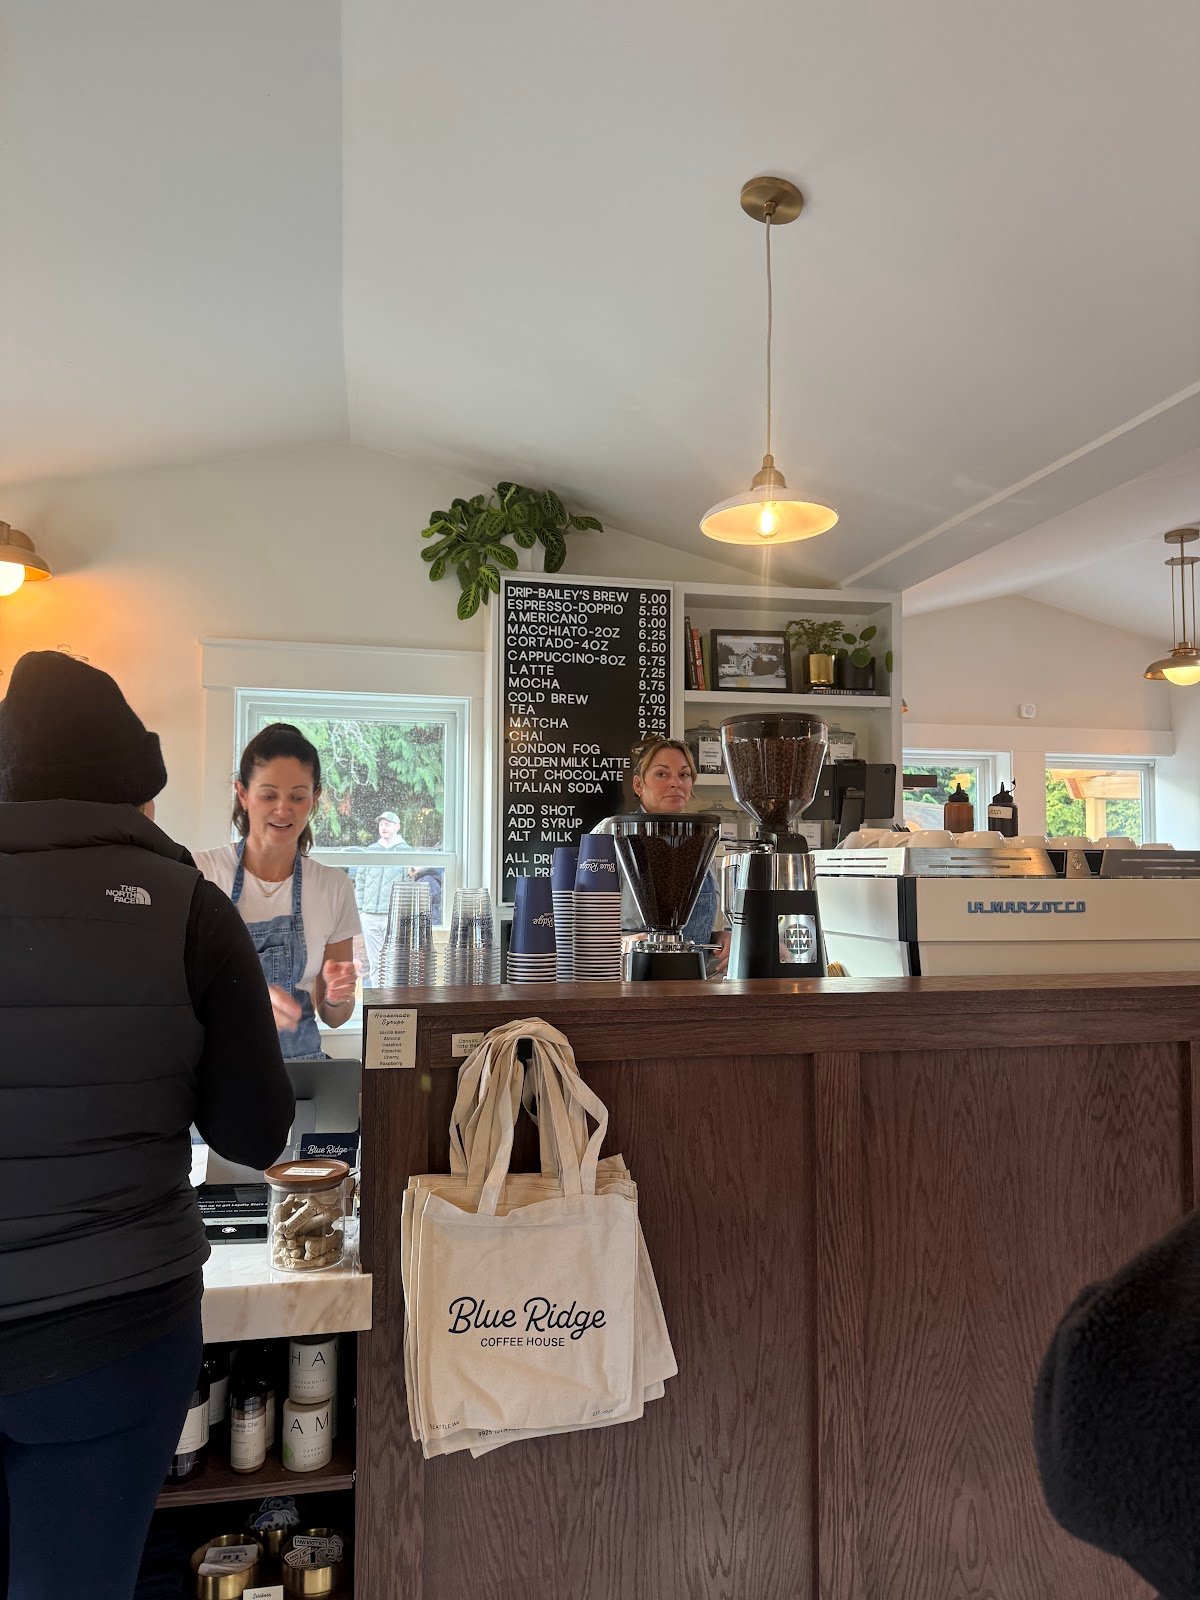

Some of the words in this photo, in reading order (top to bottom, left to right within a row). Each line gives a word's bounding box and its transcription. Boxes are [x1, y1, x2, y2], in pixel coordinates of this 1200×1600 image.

[593, 592, 629, 602] BREW
[639, 593, 667, 604] 5.00
[508, 600, 624, 615] ESPRESSO-DOPPIO
[638, 606, 667, 615] 5.50
[508, 611, 588, 624] AMERICANO
[638, 618, 667, 628] 6.00
[507, 624, 620, 638] MACCHIATO-2OZ
[638, 630, 666, 640] 6.25
[638, 642, 666, 653] 6.50
[508, 650, 626, 666] CAPPUCCINO-8OZ
[638, 656, 666, 666] 6.75
[510, 664, 554, 675] LATTE
[639, 668, 665, 678] 7.25
[508, 678, 560, 689] MOCHA
[638, 680, 665, 691] 8.75
[508, 692, 545, 703] COLD
[551, 693, 588, 705] BREW
[639, 693, 665, 704] 7.00
[510, 704, 535, 715] TEA
[638, 705, 666, 716] 5.75
[509, 717, 569, 728] MATCHA
[638, 718, 666, 729] 8.25
[509, 731, 542, 741] CHAI
[510, 743, 565, 754] LONDON
[573, 744, 601, 754] FOG
[508, 756, 559, 768] GOLDEN
[561, 757, 589, 768] MILK
[592, 758, 630, 768] LATTE
[510, 769, 537, 779] HOT
[544, 770, 624, 782] CHOCOLATE
[509, 782, 562, 793] ITALIAN
[568, 783, 603, 794] SODA
[508, 804, 534, 815] ADD
[540, 805, 575, 816] SHOT
[508, 817, 536, 828] ADD
[541, 818, 582, 828] SYRUP
[508, 830, 531, 842] ALT
[541, 831, 572, 842] MILK
[505, 853, 529, 864] ALL
[506, 868, 531, 878] ALL
[600, 863, 615, 872] Blue
[106, 889, 136, 898] NORTH
[307, 1145, 325, 1154] Blue
[326, 1144, 348, 1156] Ridge
[448, 1296, 517, 1334] Blue
[524, 1297, 606, 1340] Ridge
[481, 1338, 523, 1347] COFFEE
[526, 1337, 565, 1347] HOUSE
